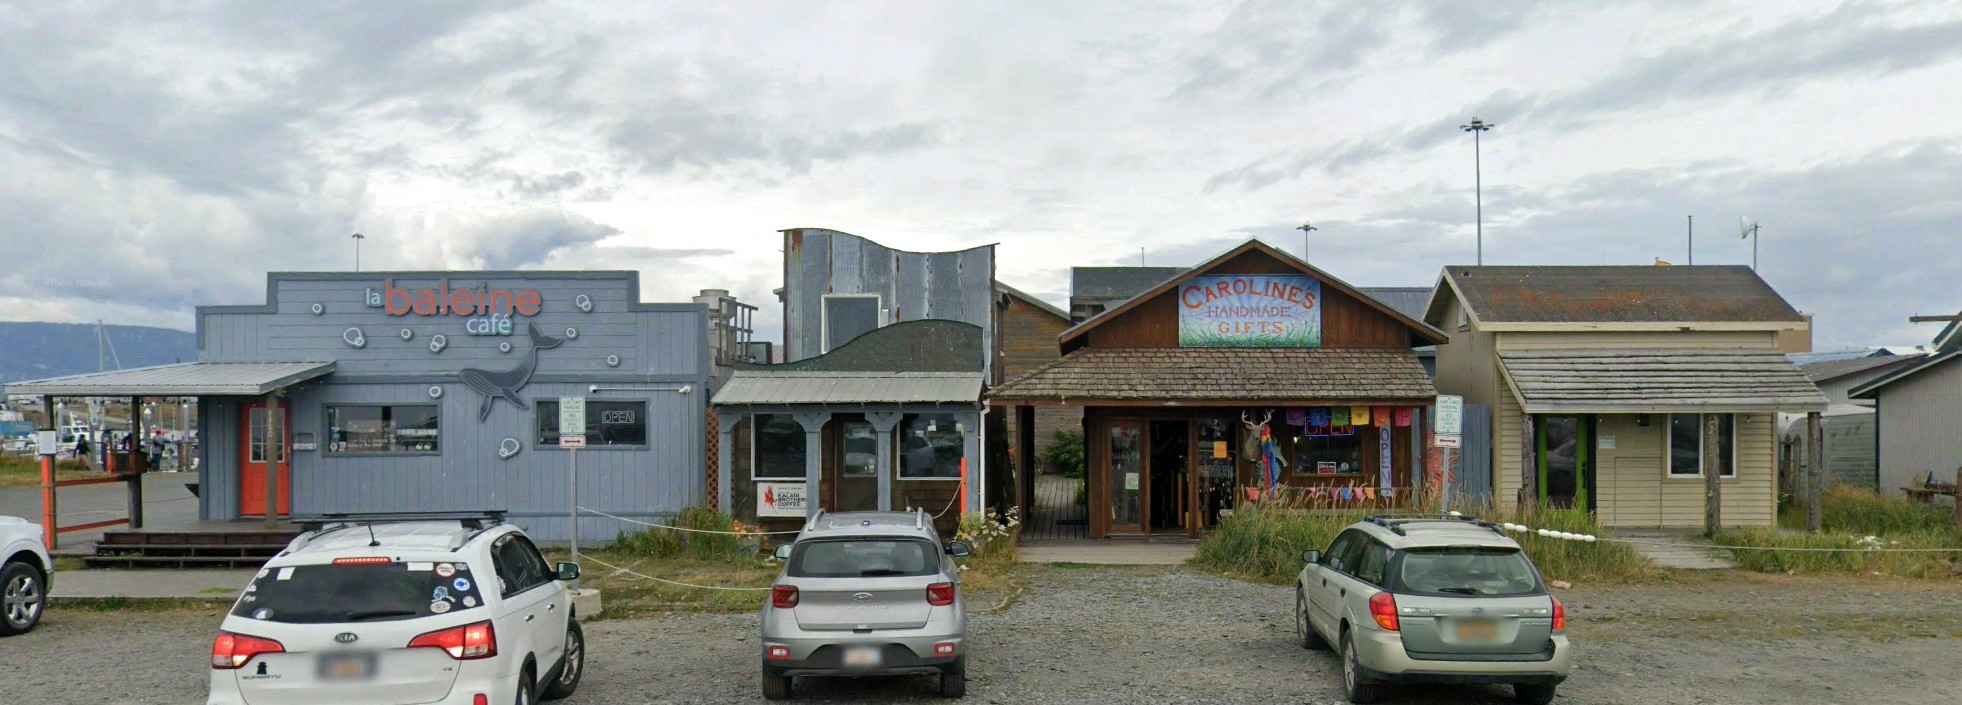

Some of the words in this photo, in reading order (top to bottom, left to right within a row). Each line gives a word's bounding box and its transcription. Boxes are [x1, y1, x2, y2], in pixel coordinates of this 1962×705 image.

[366, 287, 381, 305] la
[385, 278, 541, 316] baleine
[1181, 278, 1316, 310] CAROLINE'S
[1207, 306, 1291, 318] HANDMADE
[466, 313, 511, 334] café
[1217, 321, 1284, 334] GIFTS
[604, 411, 633, 422] OPEN
[1380, 427, 1391, 485] OPEN
